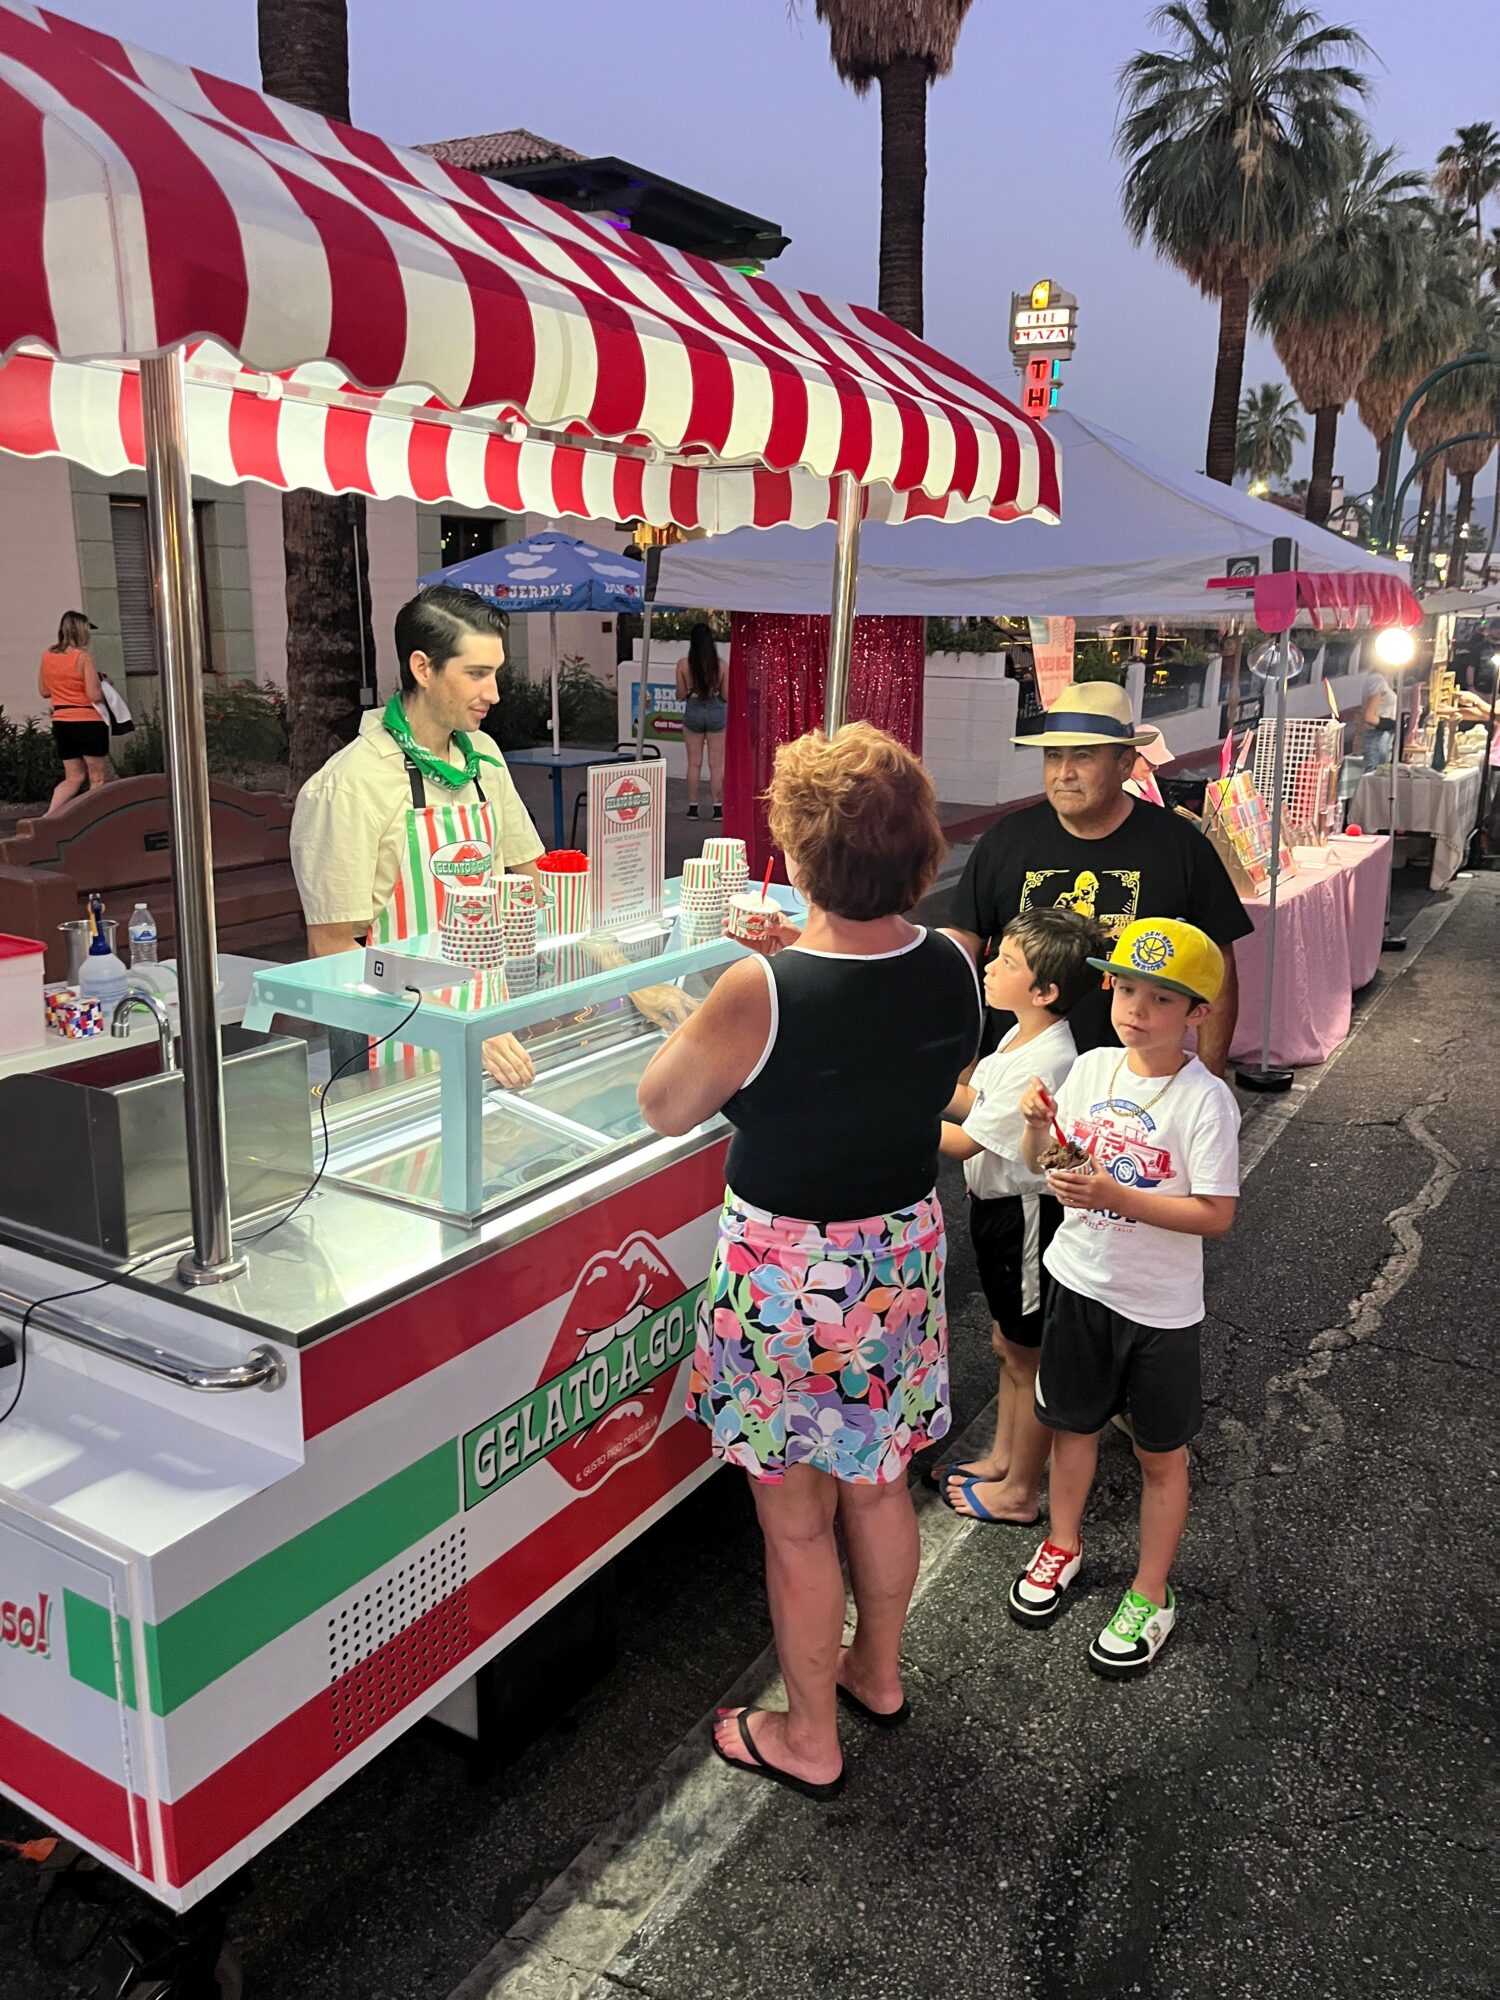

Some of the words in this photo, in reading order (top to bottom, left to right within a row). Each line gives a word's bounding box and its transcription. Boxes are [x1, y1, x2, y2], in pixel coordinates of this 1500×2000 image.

[1027, 313, 1055, 324] THE
[1015, 329, 1066, 342] PLAZA
[1131, 953, 1167, 971] WARRIORS
[583, 1454, 606, 1477] GUSTO
[607, 1442, 623, 1460] FIGO
[0, 1591, 53, 1660] so!
